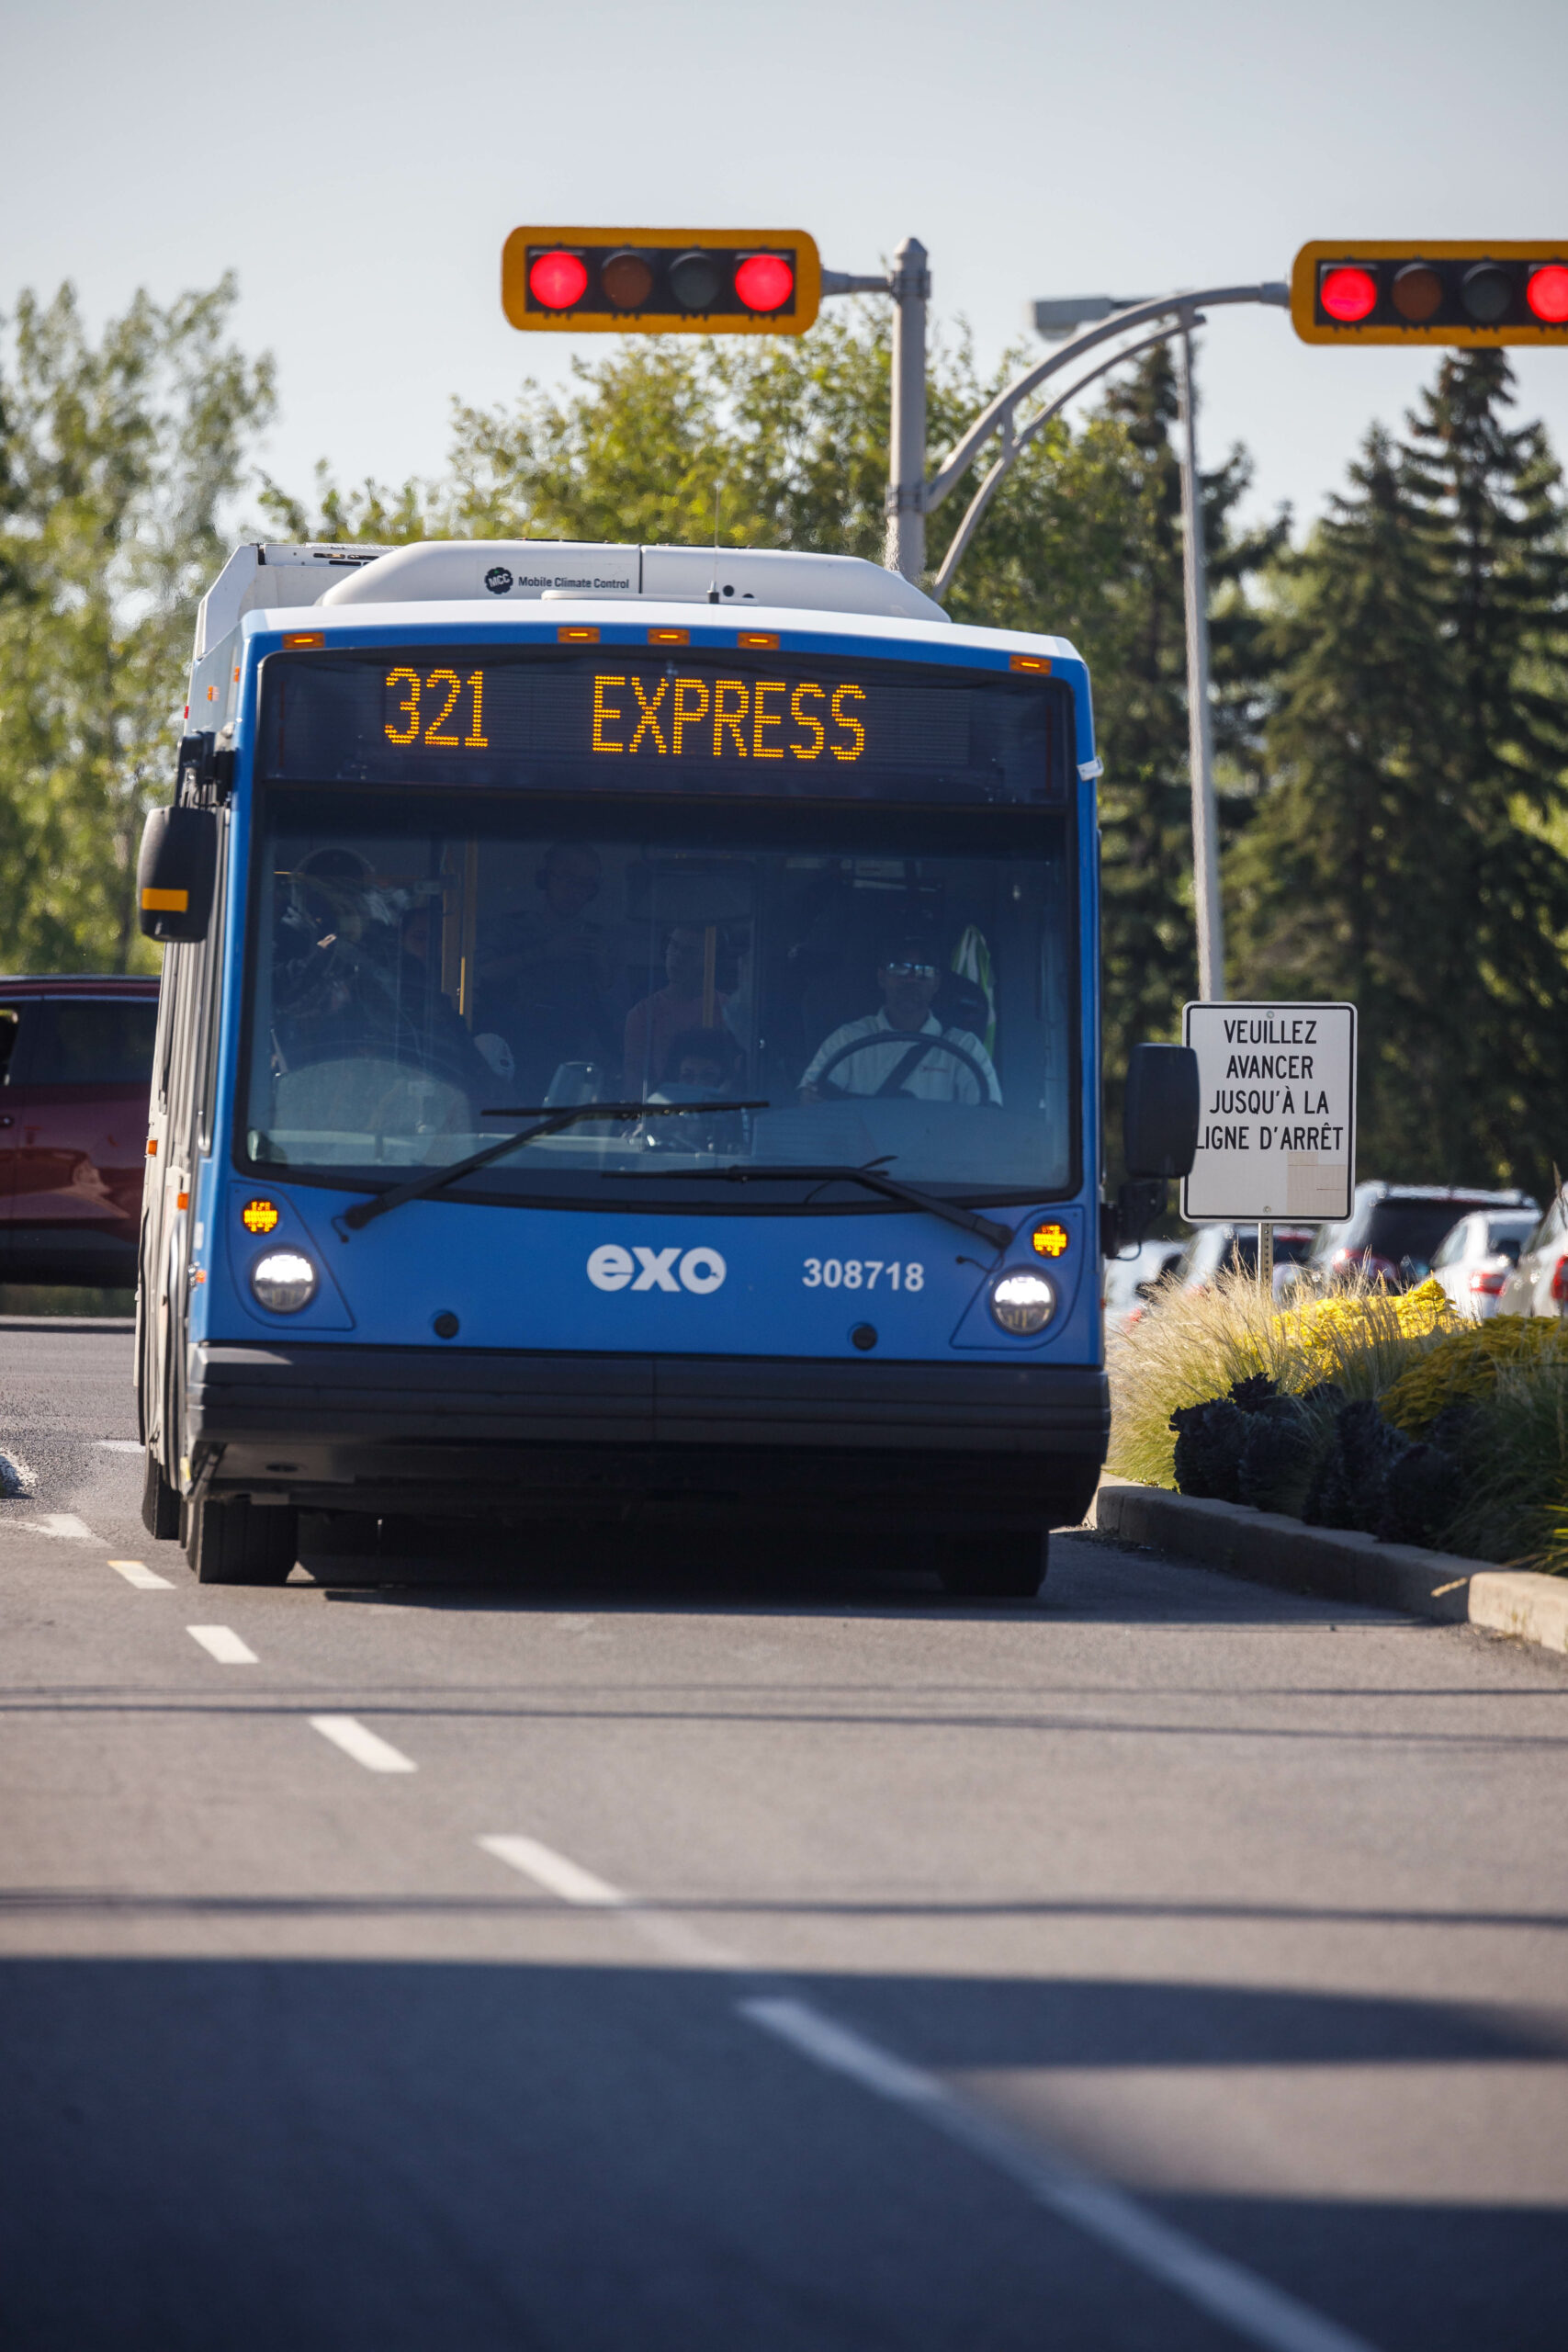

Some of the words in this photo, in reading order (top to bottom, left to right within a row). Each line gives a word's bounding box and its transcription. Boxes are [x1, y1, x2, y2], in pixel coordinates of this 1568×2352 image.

[488, 572, 511, 588] MCC
[518, 576, 551, 587] Mobile
[554, 577, 592, 588] Climate
[593, 578, 629, 589] Control
[385, 667, 488, 747] 321
[592, 676, 866, 761] EXPRESS
[1224, 1020, 1317, 1044] VEUILLEZ
[1226, 1055, 1314, 1080] AVANCER
[1209, 1085, 1295, 1114] JUSQU'À
[1304, 1091, 1329, 1114] LA
[1196, 1125, 1249, 1150] IGNE
[1260, 1122, 1344, 1150] D'ARRÊT
[586, 1244, 727, 1295] exo
[802, 1258, 924, 1292] 308718
